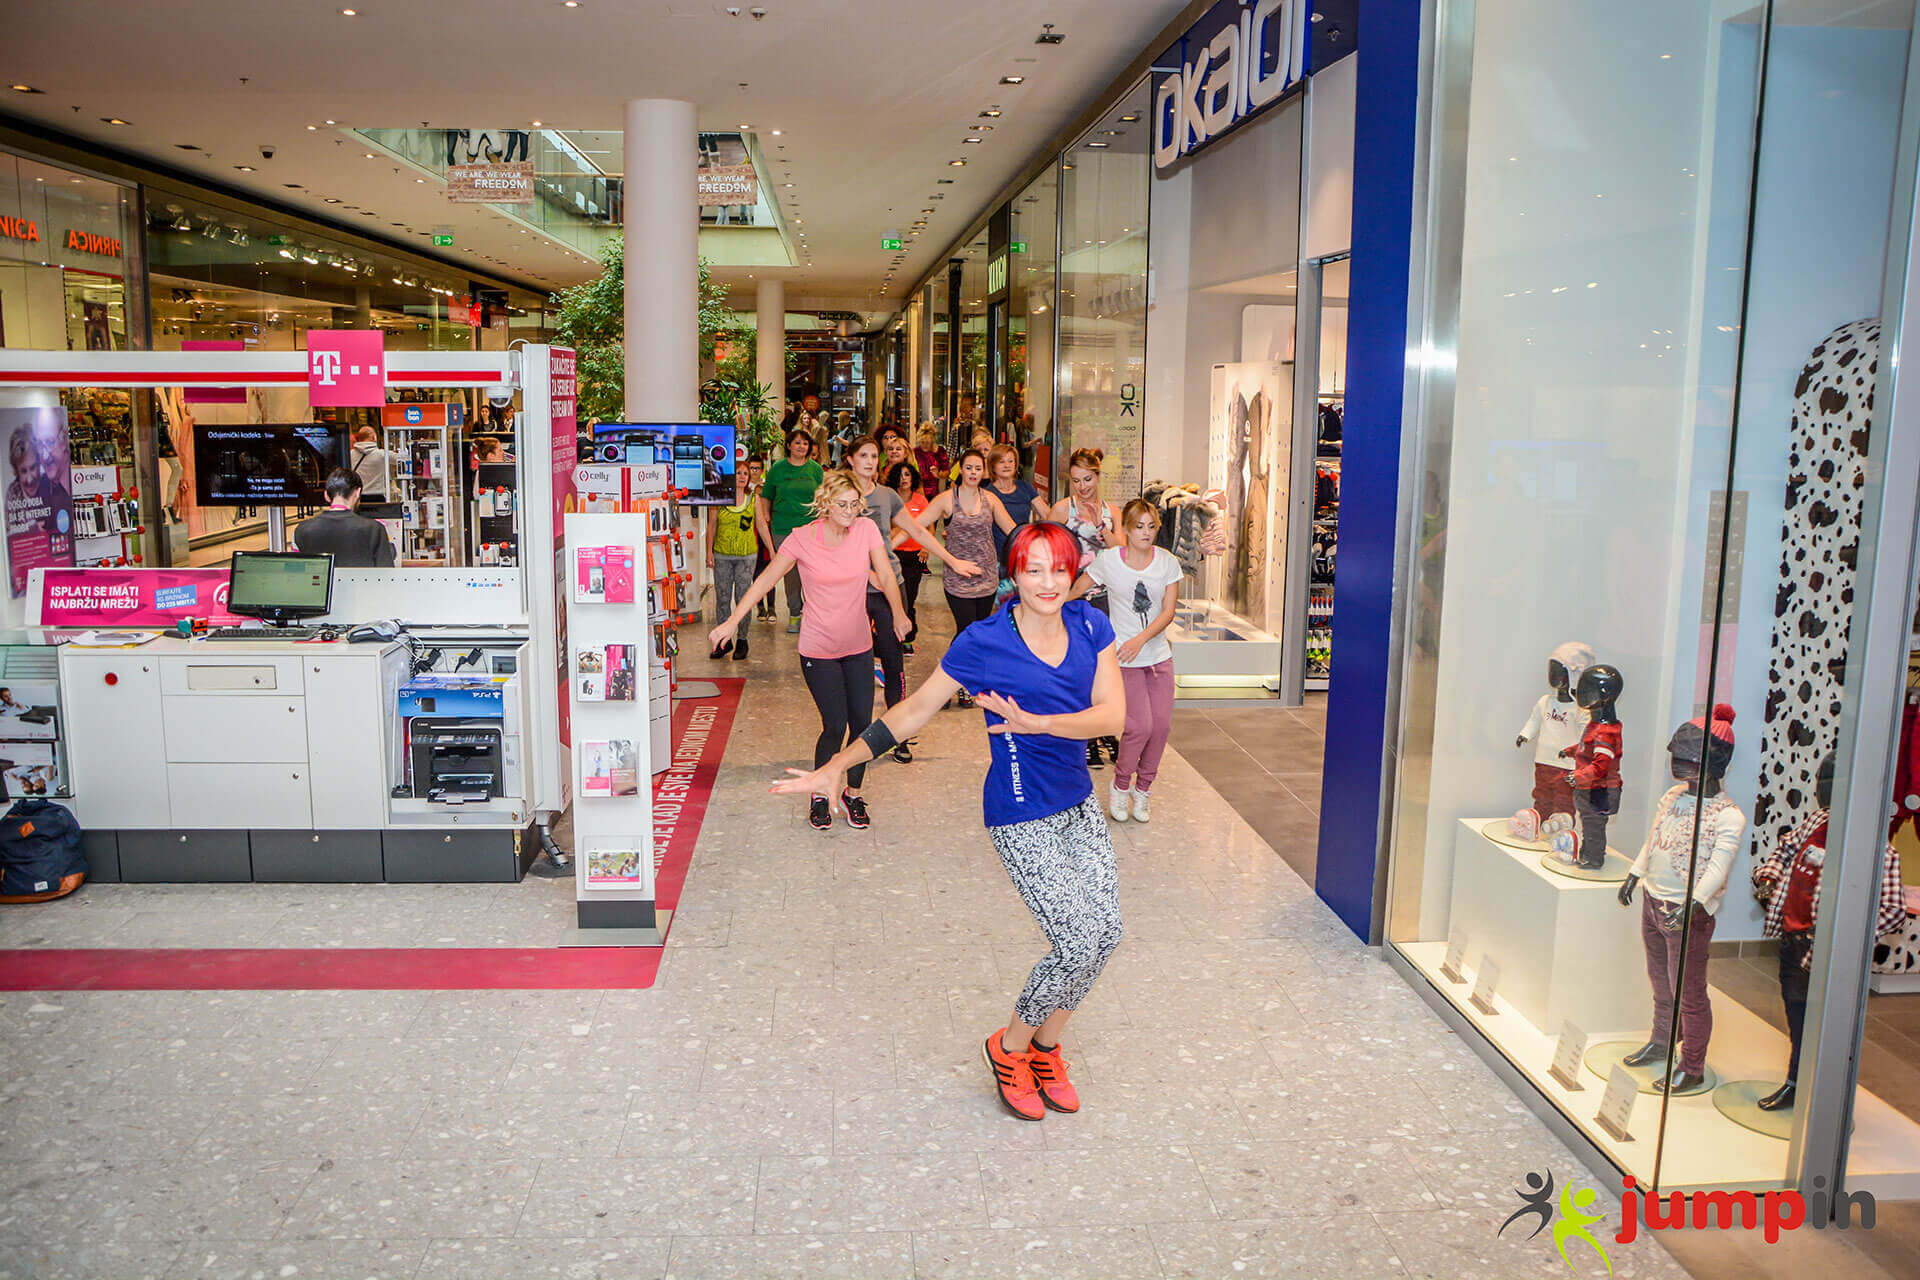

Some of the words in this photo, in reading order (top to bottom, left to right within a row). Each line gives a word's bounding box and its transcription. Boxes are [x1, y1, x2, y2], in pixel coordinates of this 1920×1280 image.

[455, 170, 467, 178] WE
[474, 179, 527, 189] FREEDOM
[698, 183, 751, 193] FREEDOM
[85, 472, 105, 482] celly
[590, 471, 609, 481] celly
[645, 470, 659, 481] celly
[51, 586, 92, 597] ISPLATI
[93, 586, 106, 597] SE
[107, 586, 139, 597] IMATI
[50, 596, 98, 609] NAJBRŽU
[98, 596, 139, 609] MREŽU
[658, 773, 695, 791] SVE
[656, 791, 687, 803] JE
[653, 803, 683, 825] KAD
